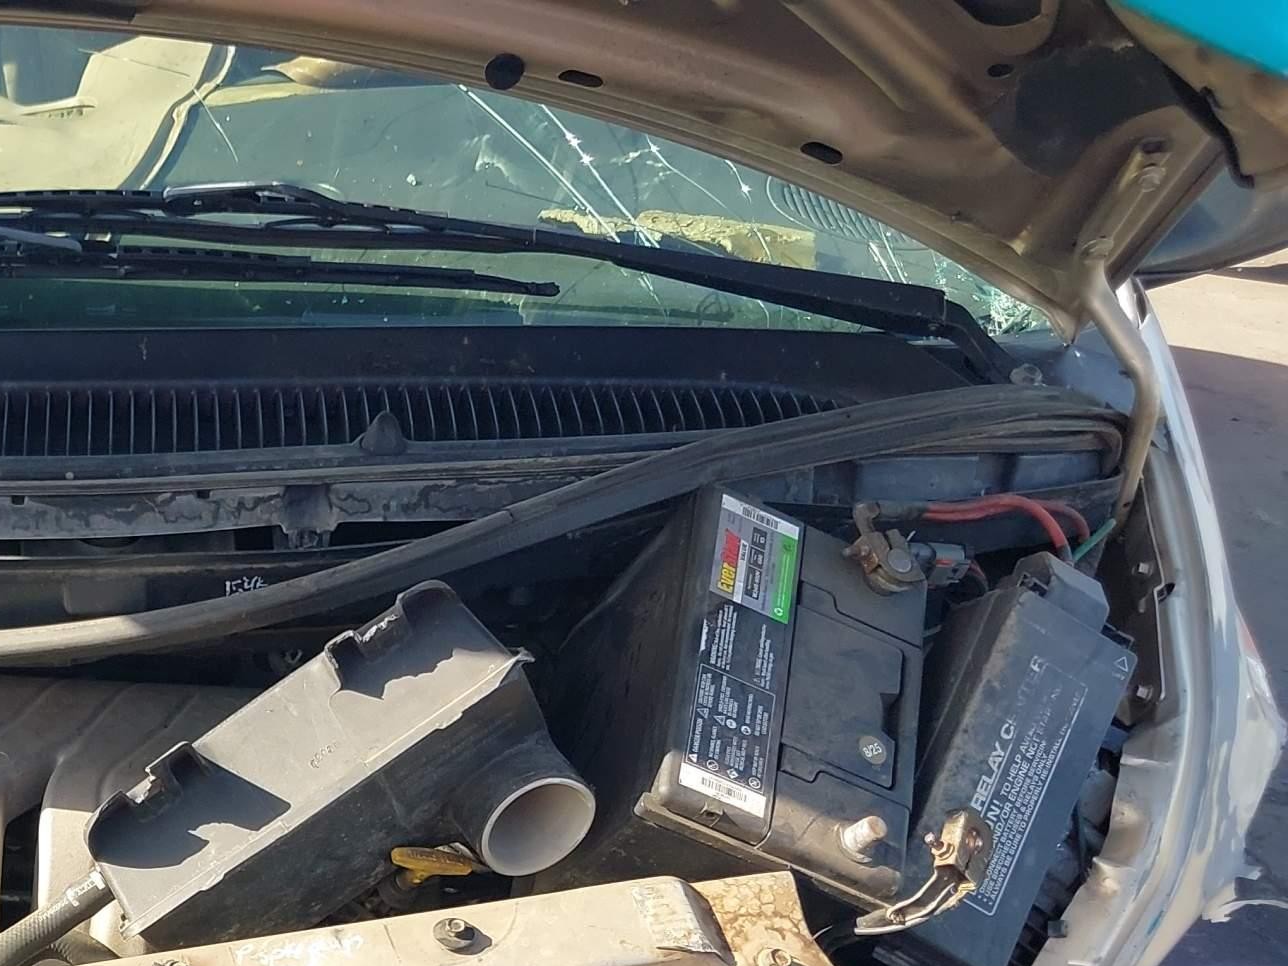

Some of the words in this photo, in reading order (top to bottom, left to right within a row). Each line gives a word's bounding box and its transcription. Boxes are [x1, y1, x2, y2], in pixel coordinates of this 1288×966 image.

[862, 742, 882, 758] 8/25
[970, 742, 1013, 816] RELAY
[999, 781, 1011, 797] TO
[1005, 753, 1023, 781] HELP
[999, 809, 1018, 843] BATTERY
[1013, 776, 1032, 808] BEFORE
[1027, 740, 1047, 776] SERVICIN
[1007, 760, 1030, 801] ENGINE
[1022, 780, 1044, 821] PROPERLY
[983, 879, 995, 896] USE
[990, 839, 1012, 880] SPECIFIED
[1007, 813, 1023, 839] FUSES
[1022, 774, 1039, 805] RELAYS
[1035, 752, 1048, 774] ONLY
[1007, 833, 1022, 855] SURE
[1017, 820, 1026, 833] TO
[1003, 854, 1012, 866] BE
[988, 866, 1008, 900] ALWAYS
